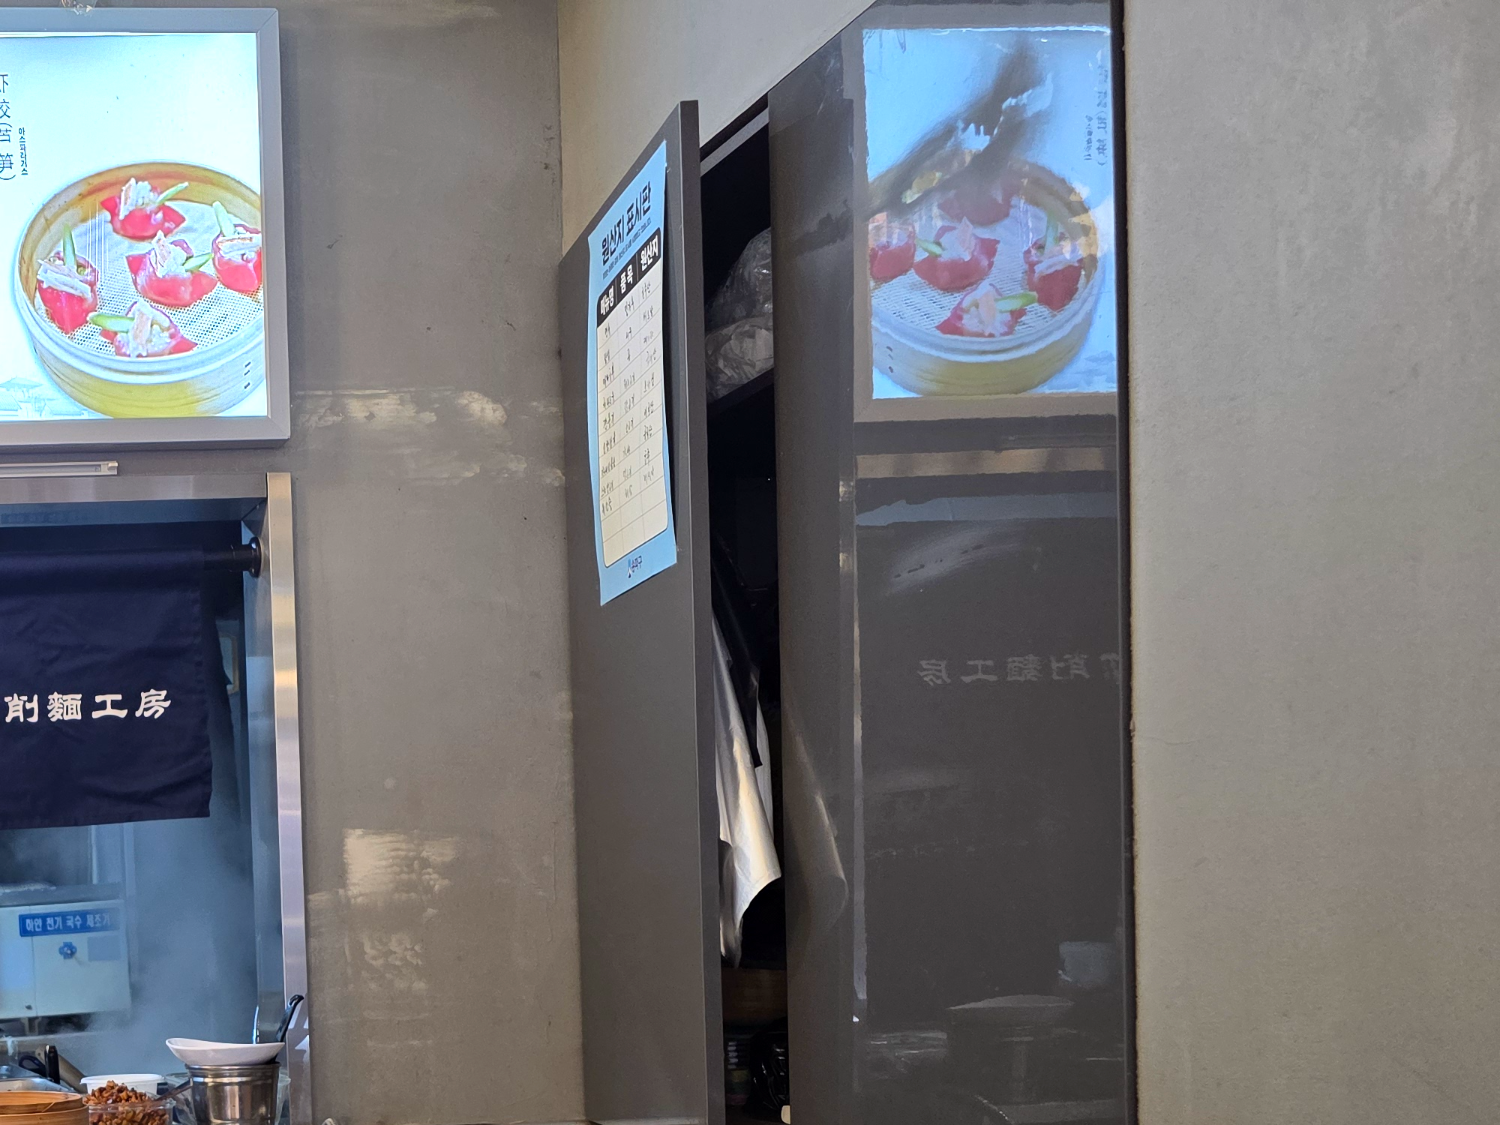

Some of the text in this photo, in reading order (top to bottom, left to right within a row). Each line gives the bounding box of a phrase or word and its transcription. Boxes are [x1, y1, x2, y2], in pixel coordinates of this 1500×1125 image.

[601, 214, 625, 267] 원산지
[626, 181, 652, 237] 표시판
[640, 235, 659, 272] 원산지
[66, 914, 83, 930] 국수
